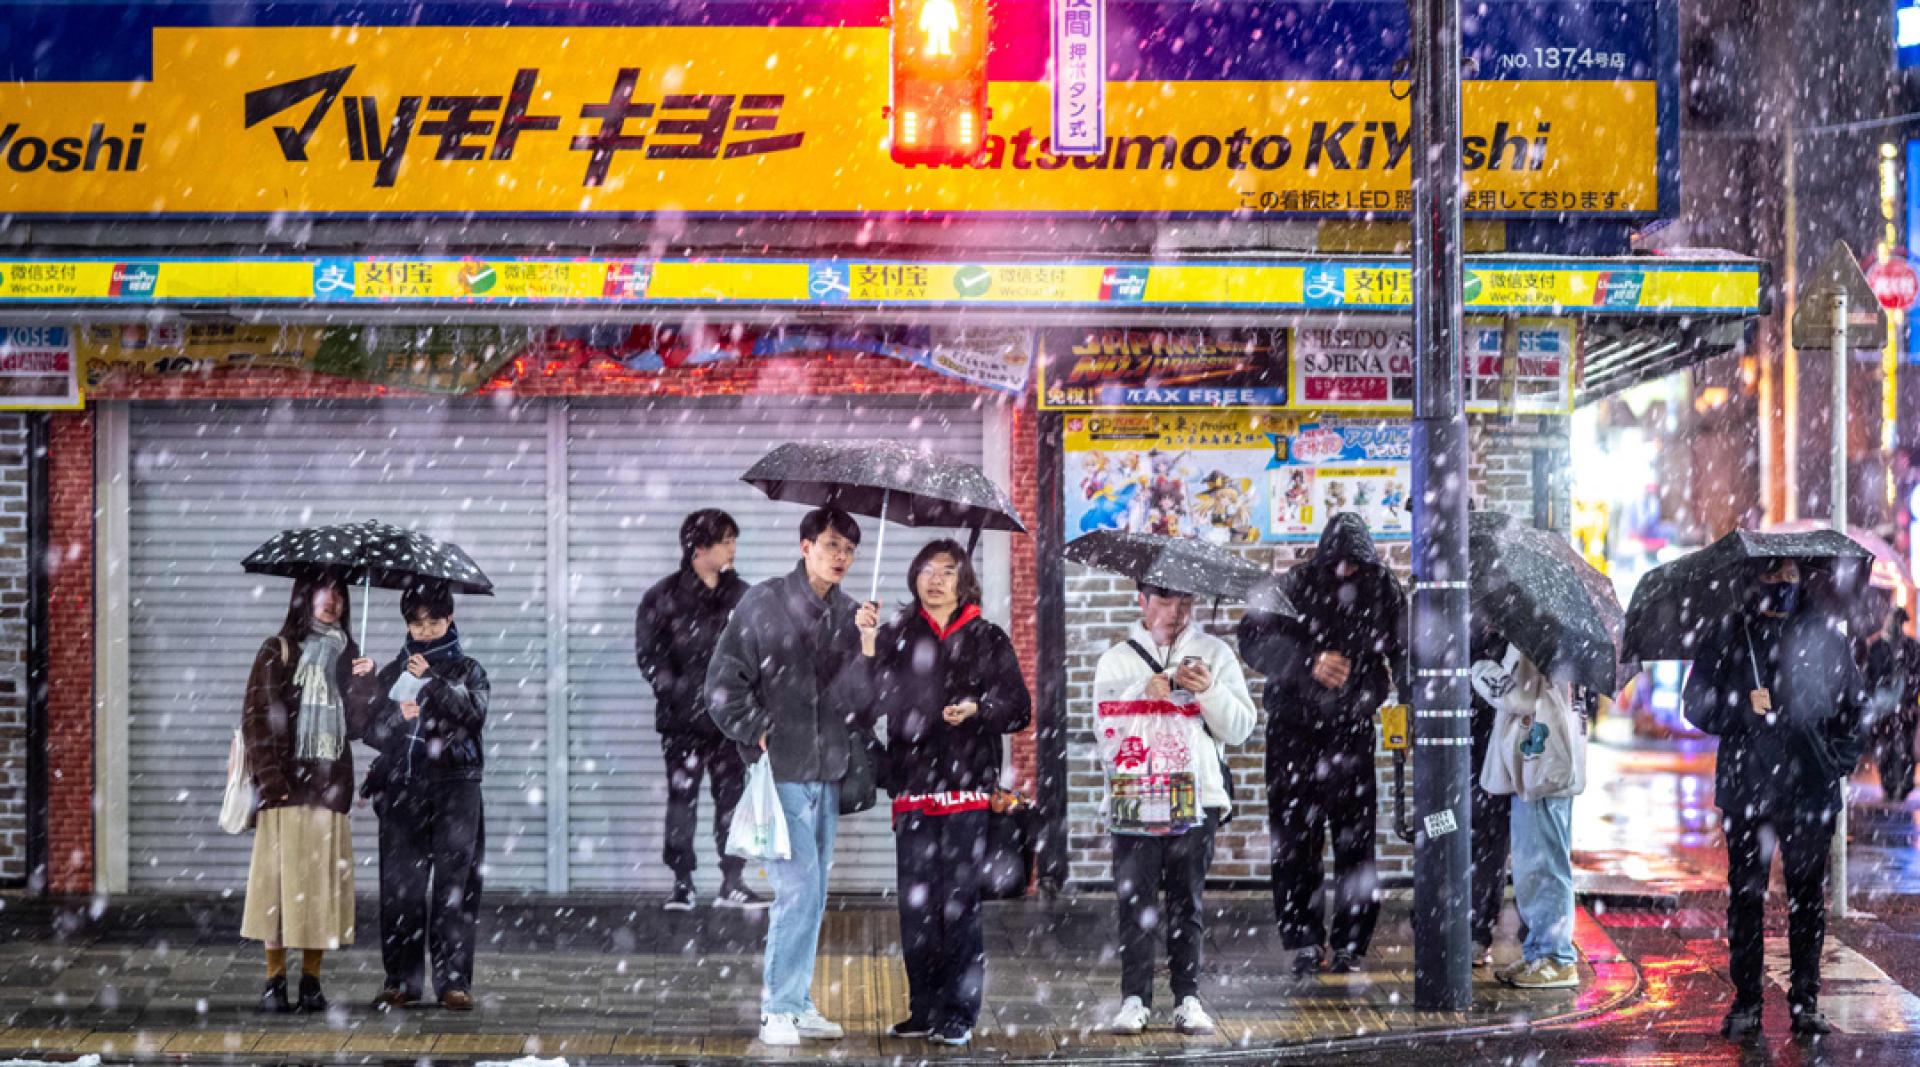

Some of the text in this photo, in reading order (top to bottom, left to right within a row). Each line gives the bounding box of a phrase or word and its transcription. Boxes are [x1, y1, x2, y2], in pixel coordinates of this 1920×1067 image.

[1064, 0, 1092, 138] 間 押ボタン式
[244, 64, 805, 188] マツモトキヨシ
[903, 121, 1551, 171] atsumoto KiYshi
[1347, 191, 1389, 208] LED
[1396, 190, 1631, 209] 照使用しております。
[366, 263, 432, 283] 支付宝
[858, 266, 928, 286] 支付宝
[11, 284, 77, 294] WeChat Pay
[366, 286, 431, 295] ALIPAY
[860, 288, 926, 297] ALIPAY
[1355, 294, 1411, 303] ALIPA
[1304, 353, 1384, 373] SOFINA
[1188, 389, 1255, 403] FREE
